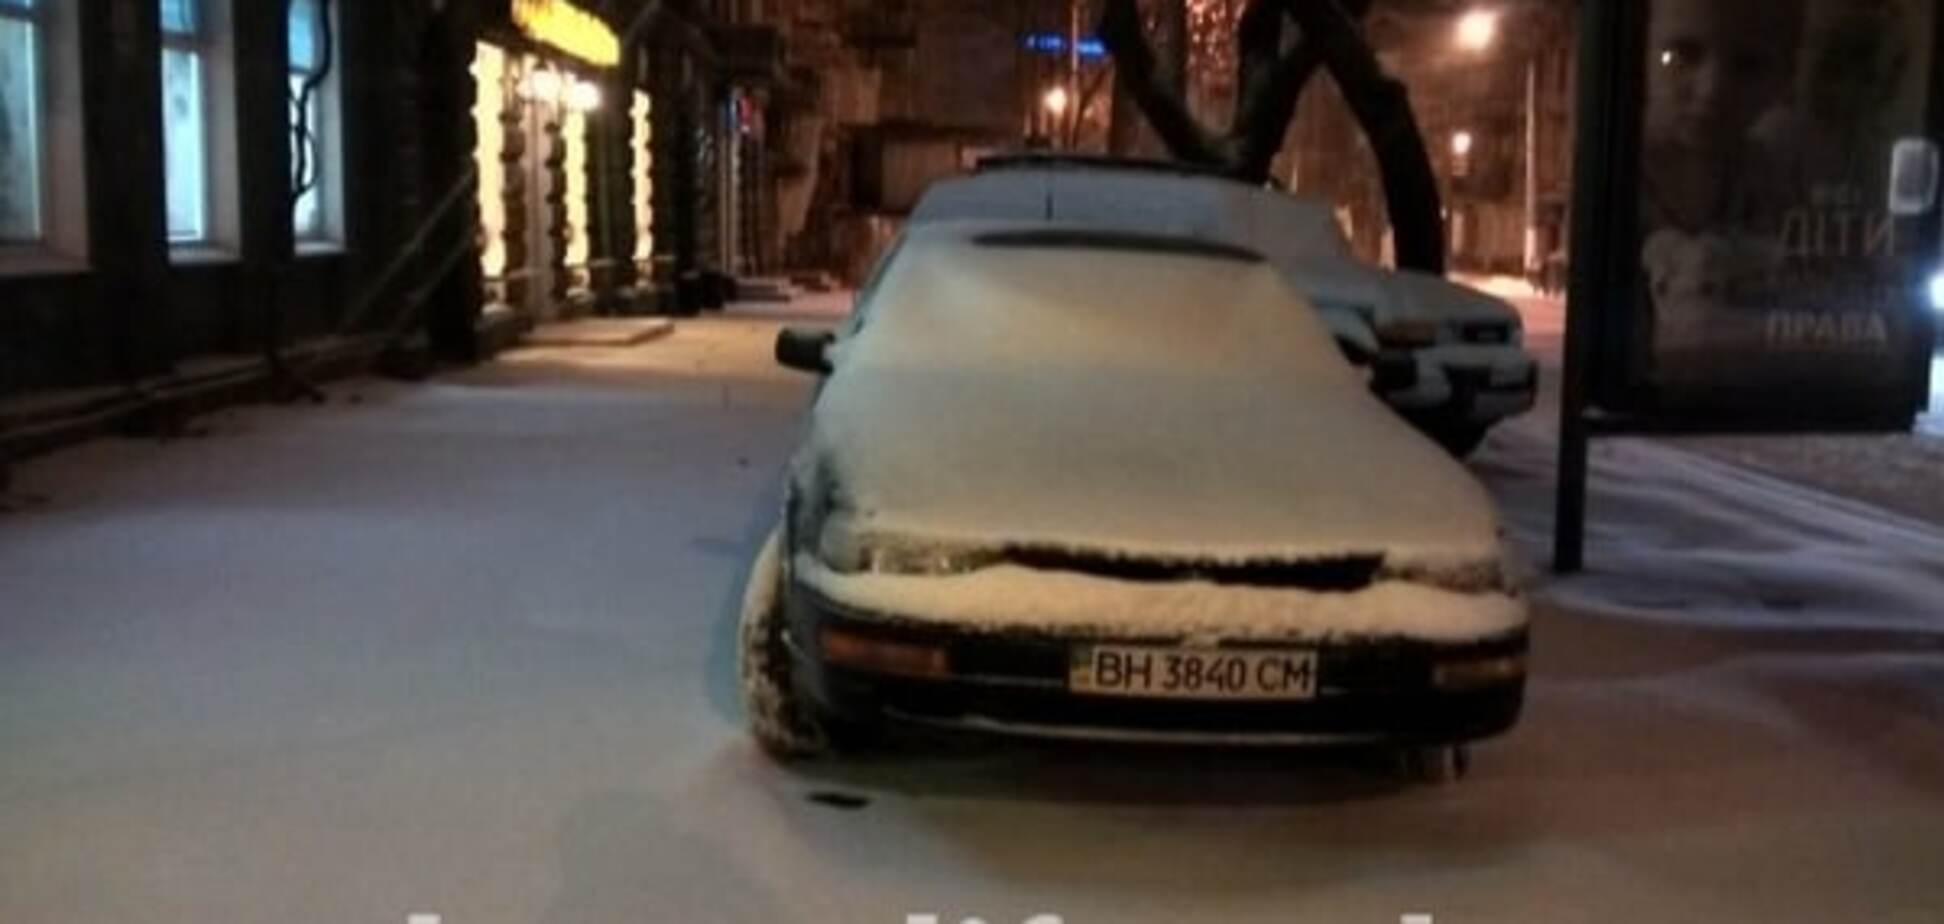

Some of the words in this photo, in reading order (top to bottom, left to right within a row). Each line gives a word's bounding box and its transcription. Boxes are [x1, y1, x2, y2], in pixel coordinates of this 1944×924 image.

[1772, 207, 1894, 258] ДІТИ
[1765, 309, 1888, 343] ПРАВА
[1096, 651, 1152, 689] BH
[1163, 654, 1247, 692] 3840
[1256, 656, 1310, 692] CM
